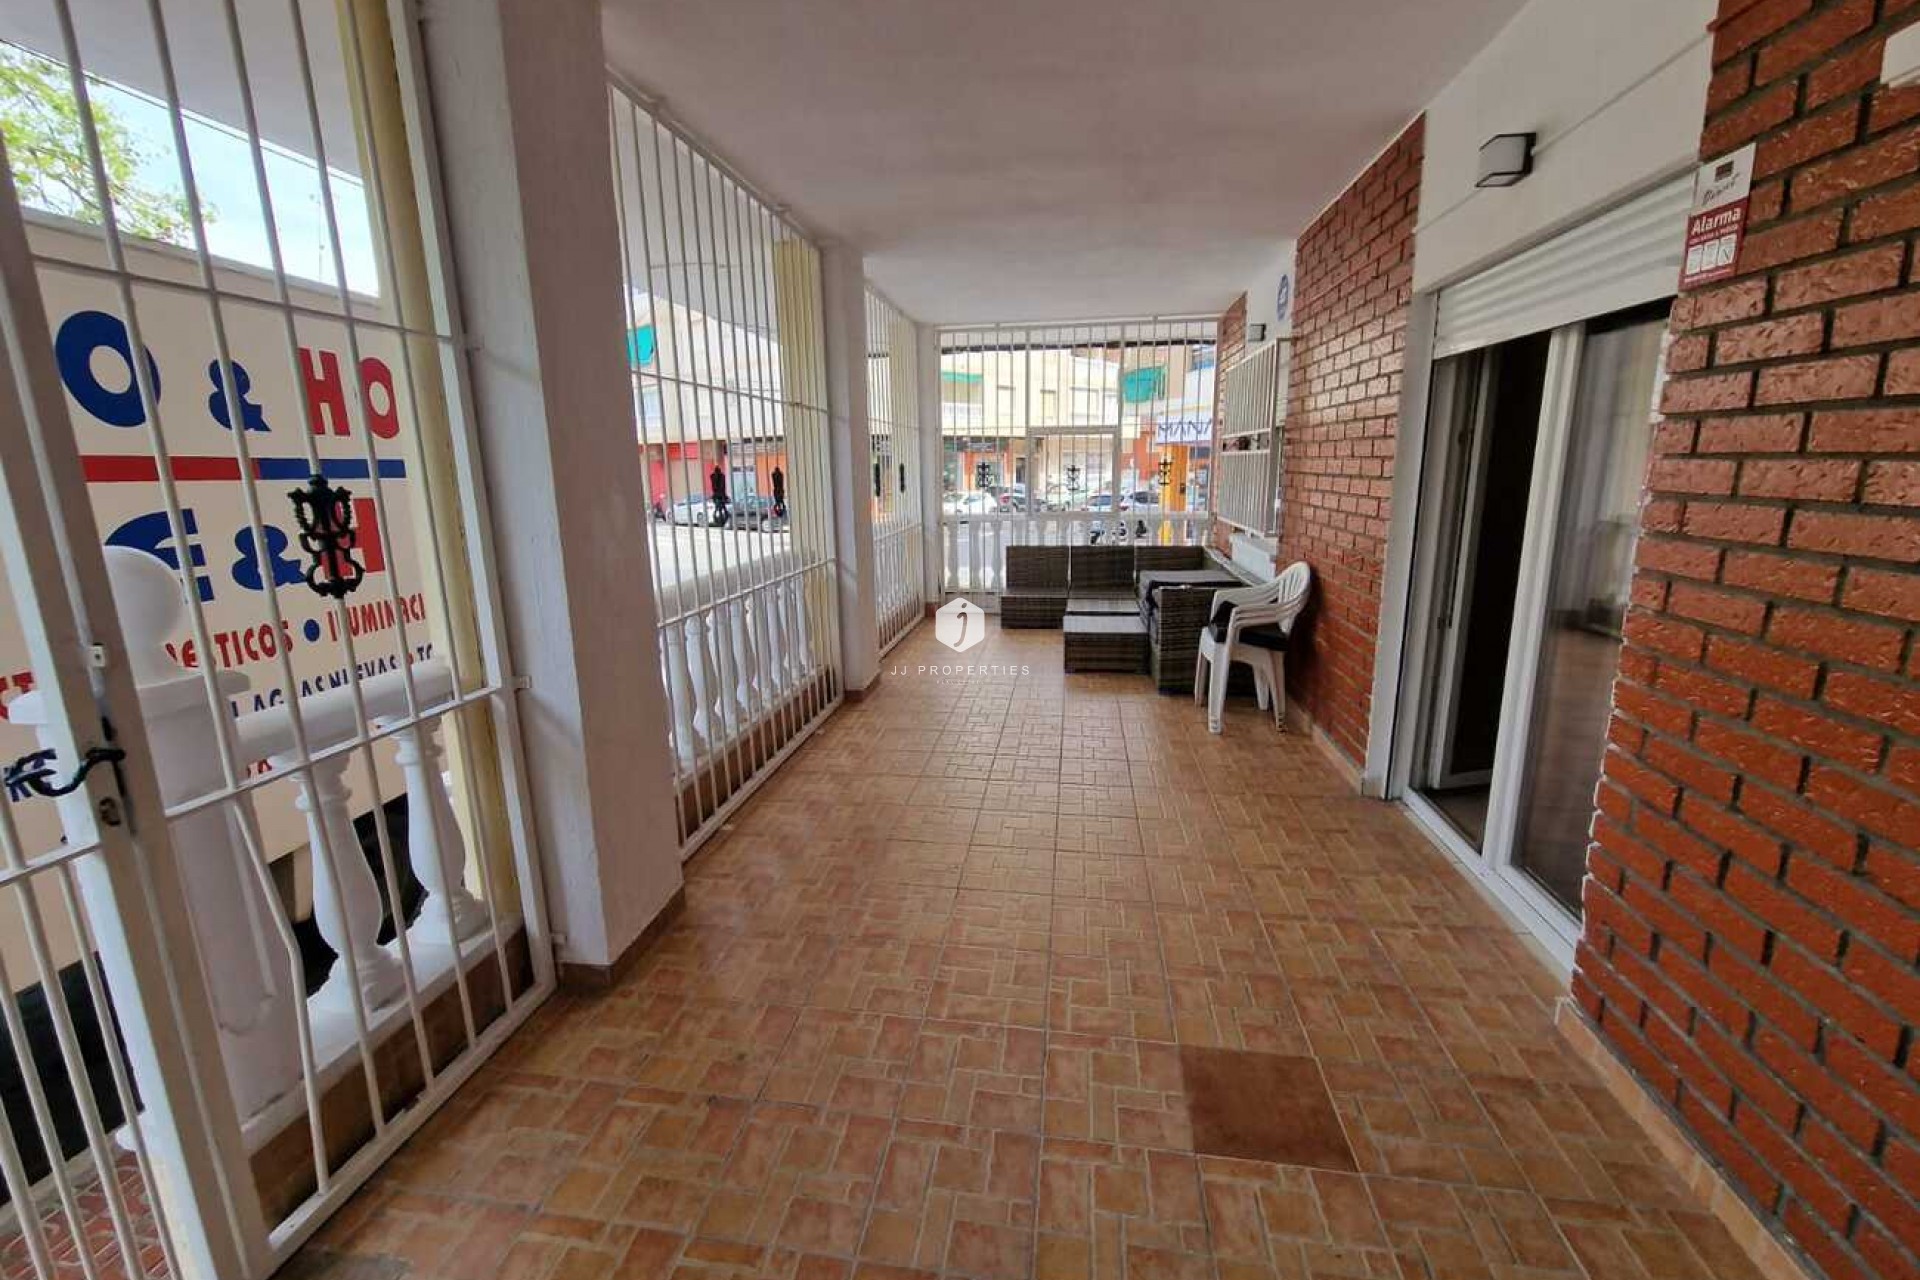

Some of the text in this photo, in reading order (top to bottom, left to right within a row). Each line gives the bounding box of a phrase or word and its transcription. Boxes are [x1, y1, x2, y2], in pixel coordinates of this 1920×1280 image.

[1691, 207, 1741, 236] Alarma
[208, 359, 271, 432] &
[231, 524, 308, 591] &
